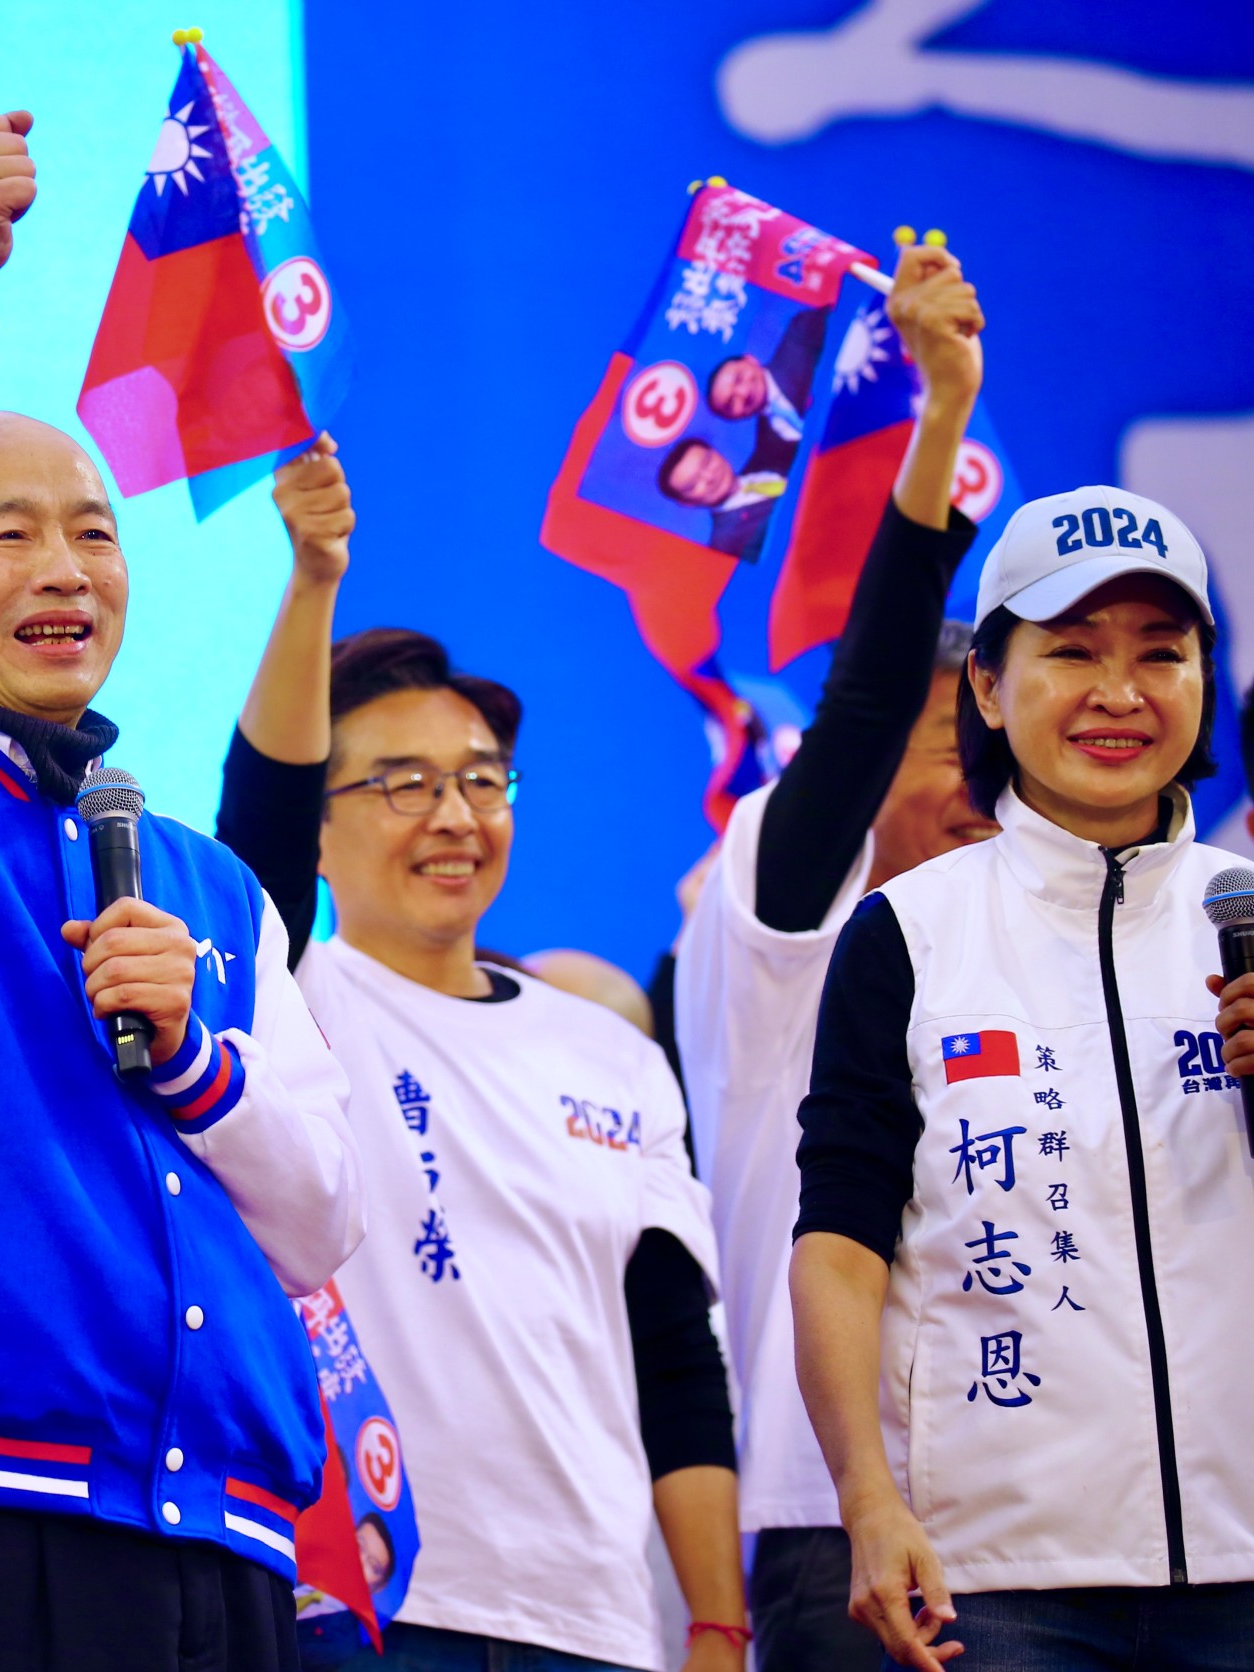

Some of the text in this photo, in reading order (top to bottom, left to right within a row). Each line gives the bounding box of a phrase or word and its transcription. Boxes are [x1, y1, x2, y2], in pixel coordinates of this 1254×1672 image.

[1052, 506, 1169, 559] 2024
[559, 1094, 643, 1151] 2024
[1033, 1044, 1086, 1312] 策略群召集人
[949, 1118, 1042, 1408] 柯志恩
